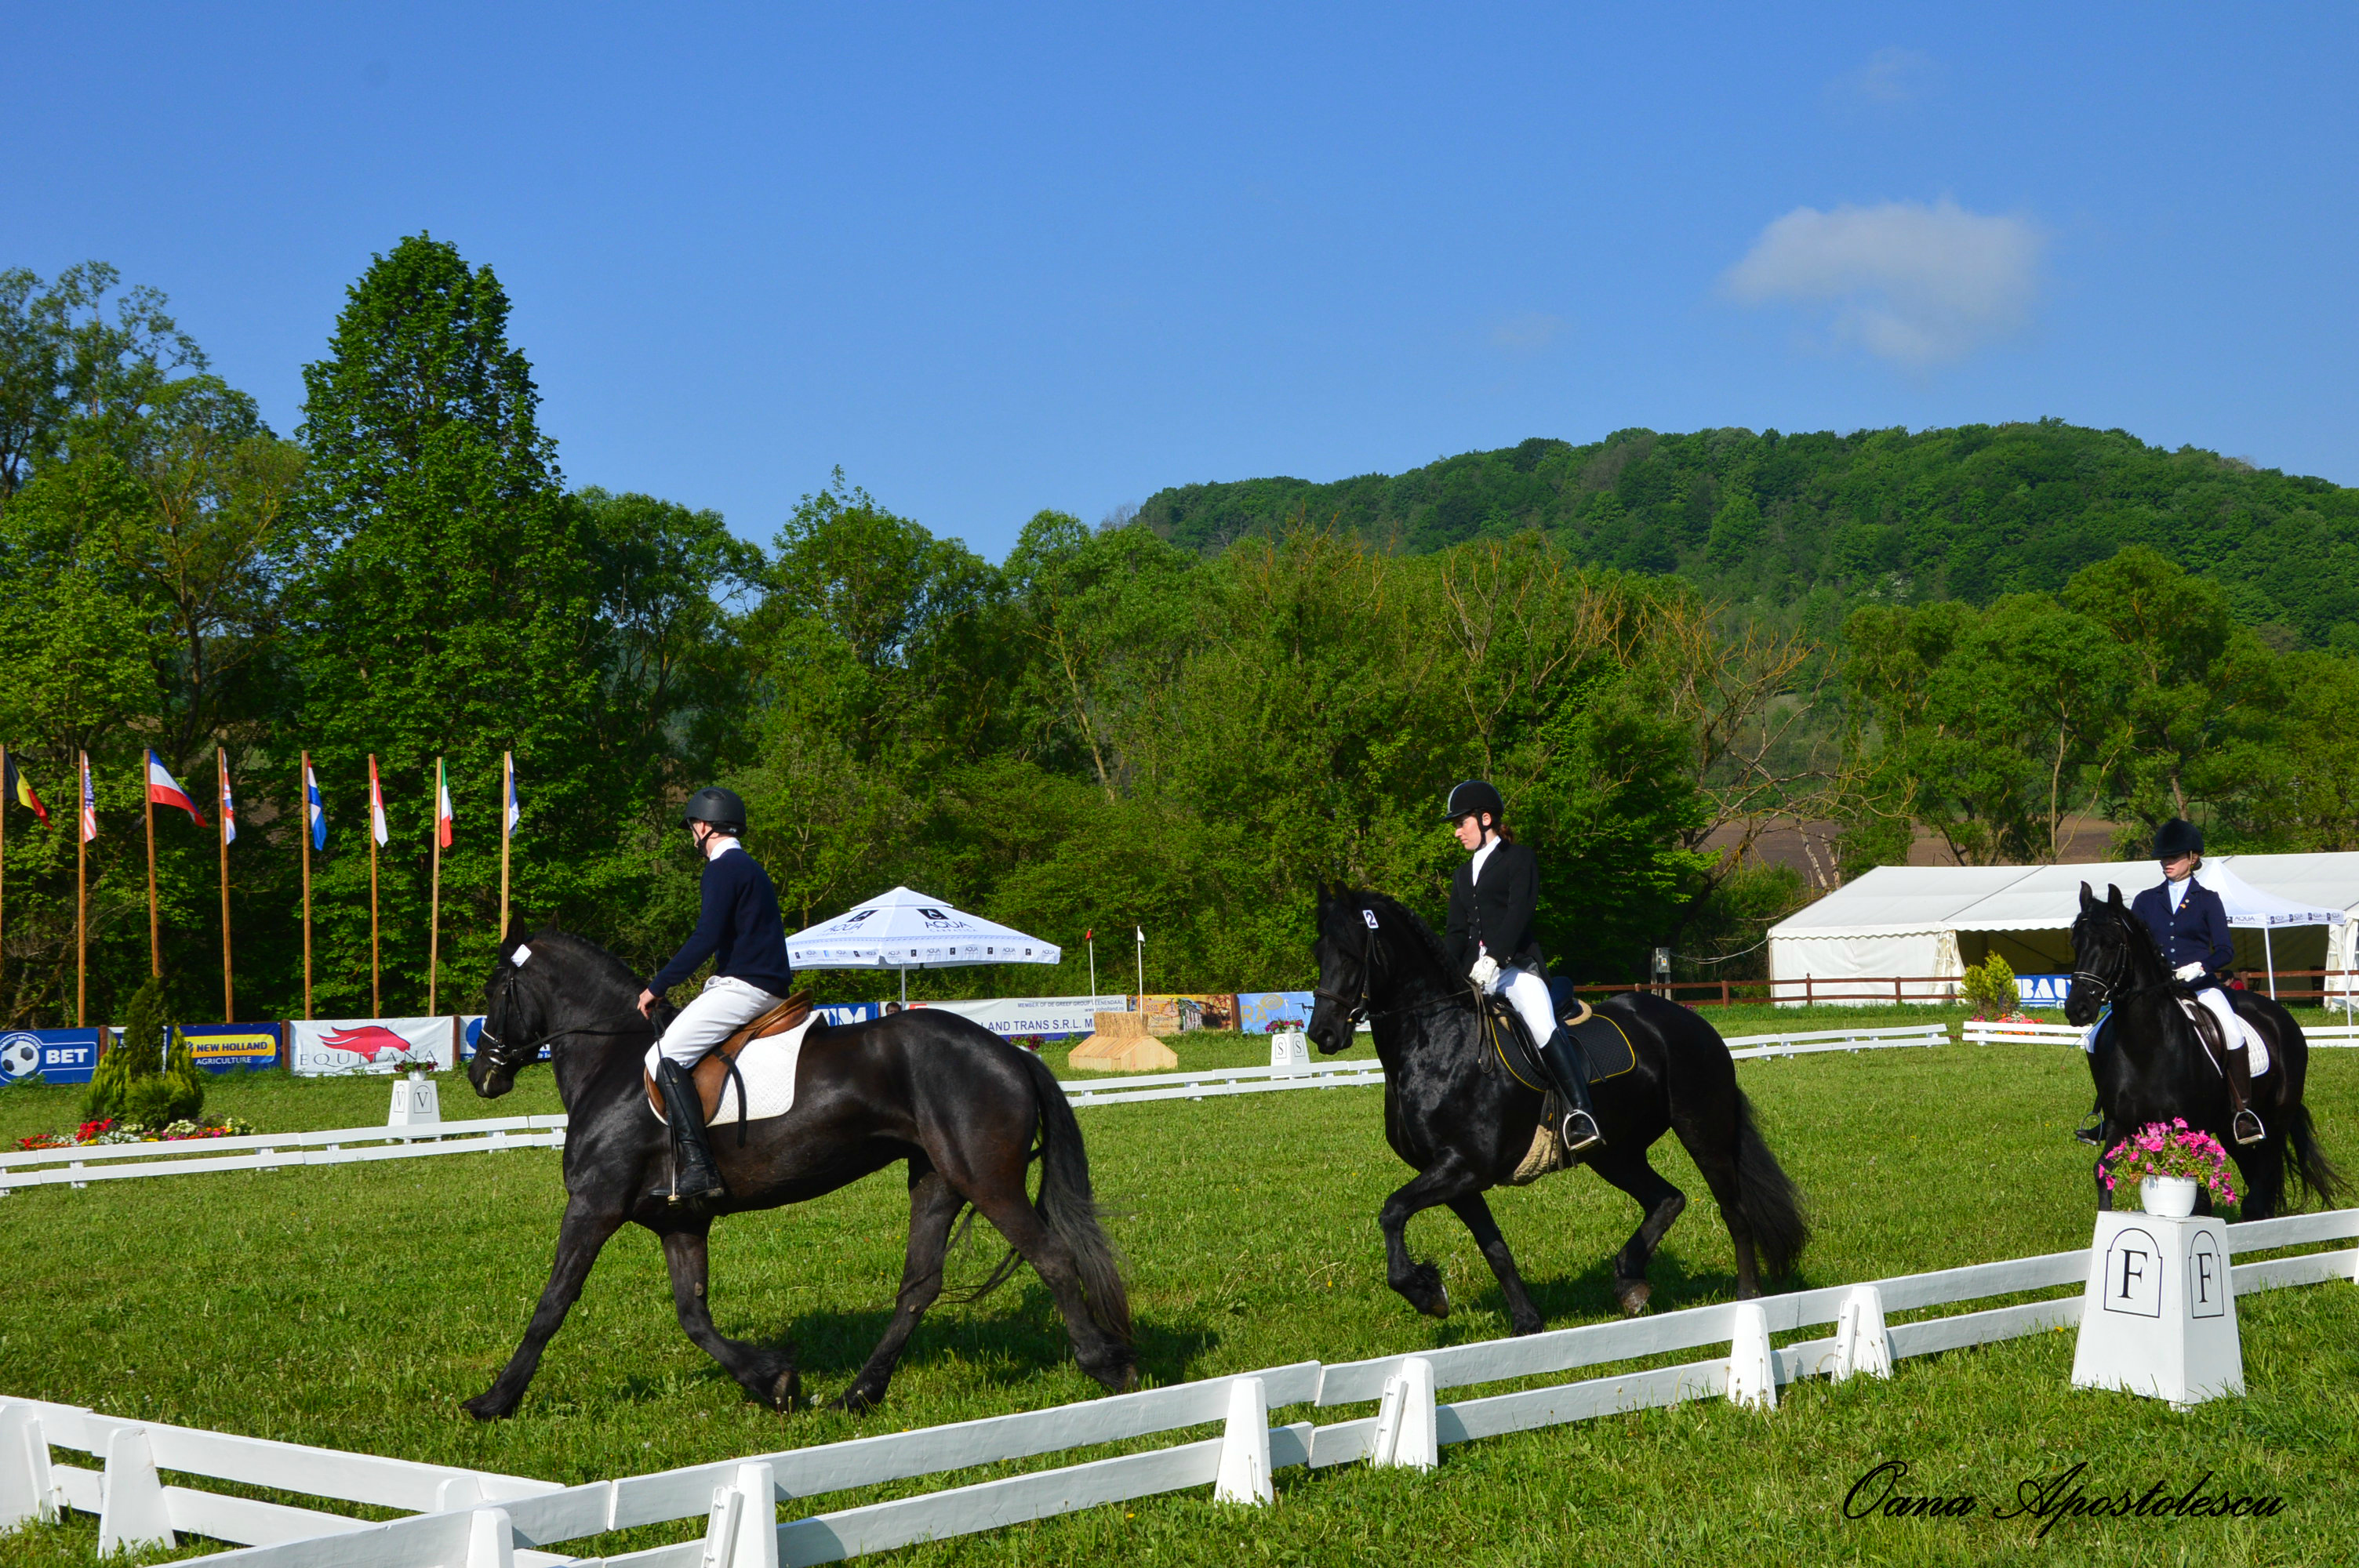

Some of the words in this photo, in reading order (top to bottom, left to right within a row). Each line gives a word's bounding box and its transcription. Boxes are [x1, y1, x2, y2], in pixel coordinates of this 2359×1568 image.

[1366, 912, 1376, 926] 2
[981, 1021, 1011, 1032] AND
[1014, 1020, 1049, 1031] TRANS
[1052, 1018, 1081, 1030] S.R.L.
[196, 1044, 220, 1052] NEW
[222, 1041, 267, 1051] HOLLAND
[1278, 1042, 1284, 1055] S
[1295, 1040, 1302, 1053] S
[45, 1048, 89, 1064] BET
[196, 1057, 252, 1065] AGRICULTURE
[300, 1050, 437, 1068] EQUITANA
[396, 1091, 404, 1108] V
[417, 1092, 428, 1108] V
[2117, 1248, 2148, 1300] F
[2196, 1252, 2213, 1303] F
